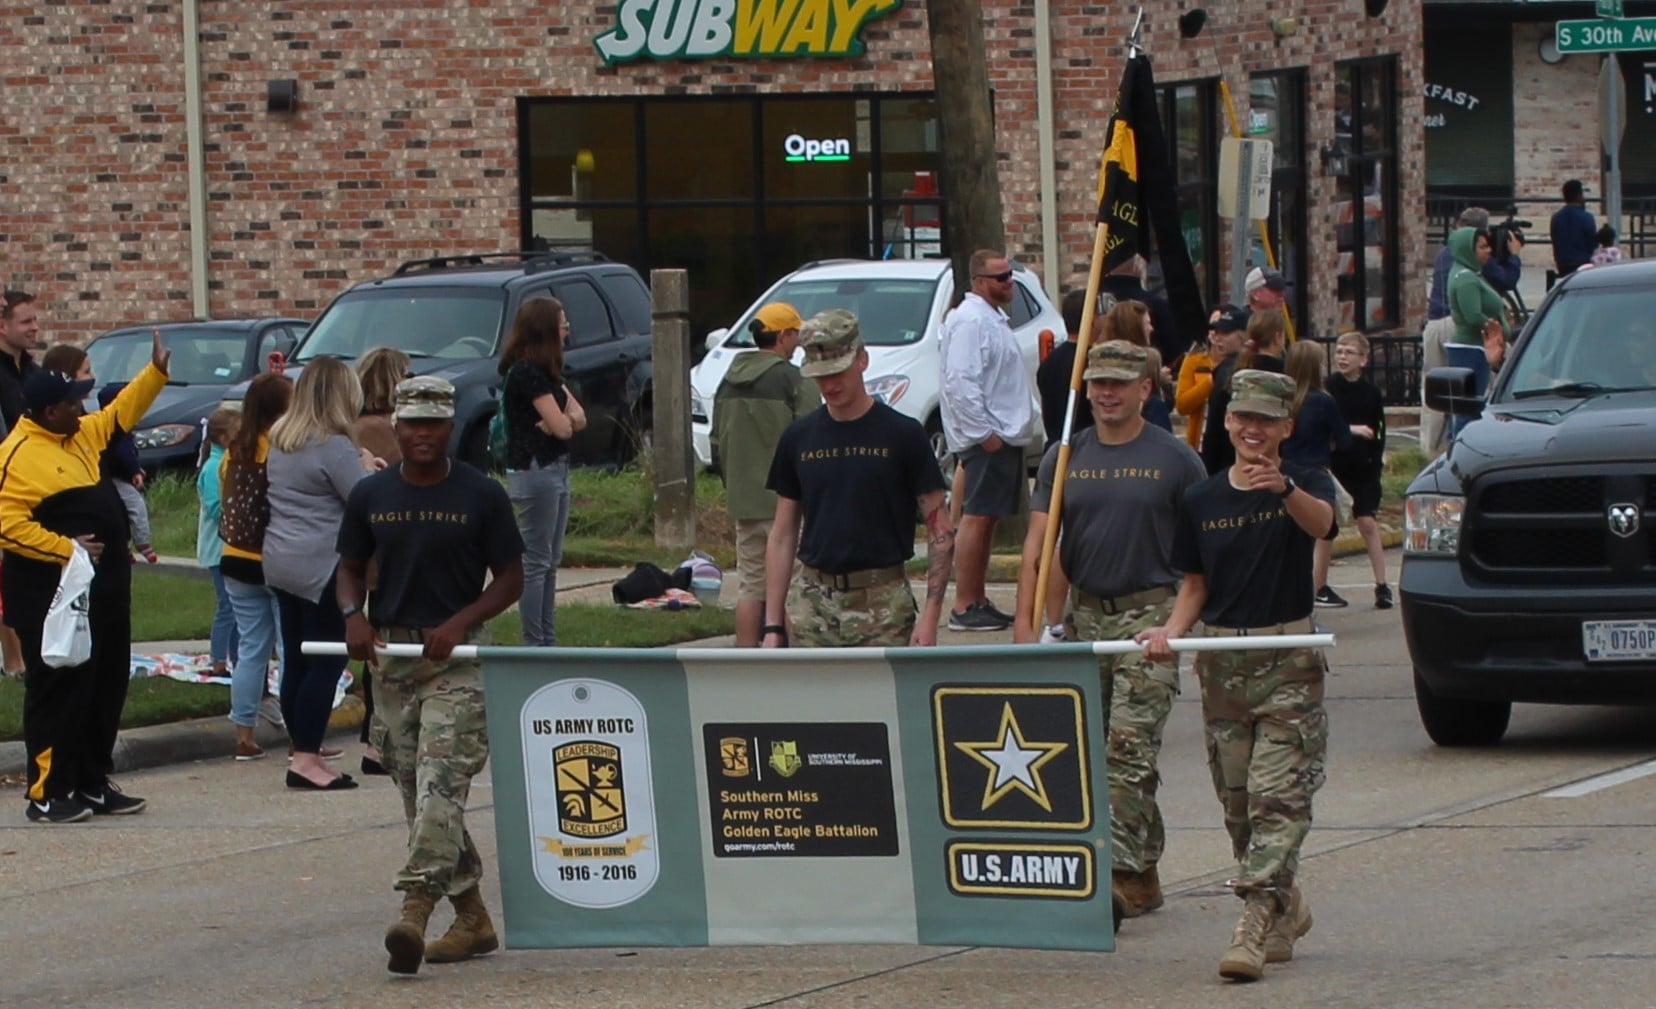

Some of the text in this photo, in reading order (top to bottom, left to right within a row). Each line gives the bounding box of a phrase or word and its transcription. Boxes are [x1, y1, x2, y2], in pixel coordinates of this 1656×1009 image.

[596, 0, 896, 59] SUBWAY
[1560, 24, 1656, 46] S 30th Av
[784, 134, 850, 161] Open
[801, 446, 889, 461] EAGLE STRIKE
[1113, 467, 1161, 480] STRIKE
[371, 511, 468, 524] EAGLE STRIKE
[533, 718, 634, 734] US ARMY ROTC
[557, 744, 616, 760] LEADERSHIP
[721, 791, 818, 803] Southern Miss
[722, 808, 802, 822] Army ROTC
[563, 820, 622, 834] EXCELLENCE
[723, 825, 878, 839] Golden Eagle Battalion
[574, 847, 592, 856] YEARS
[724, 842, 795, 853] goarmy.com/rotc
[558, 866, 590, 880] 1916
[601, 865, 637, 880] 2016
